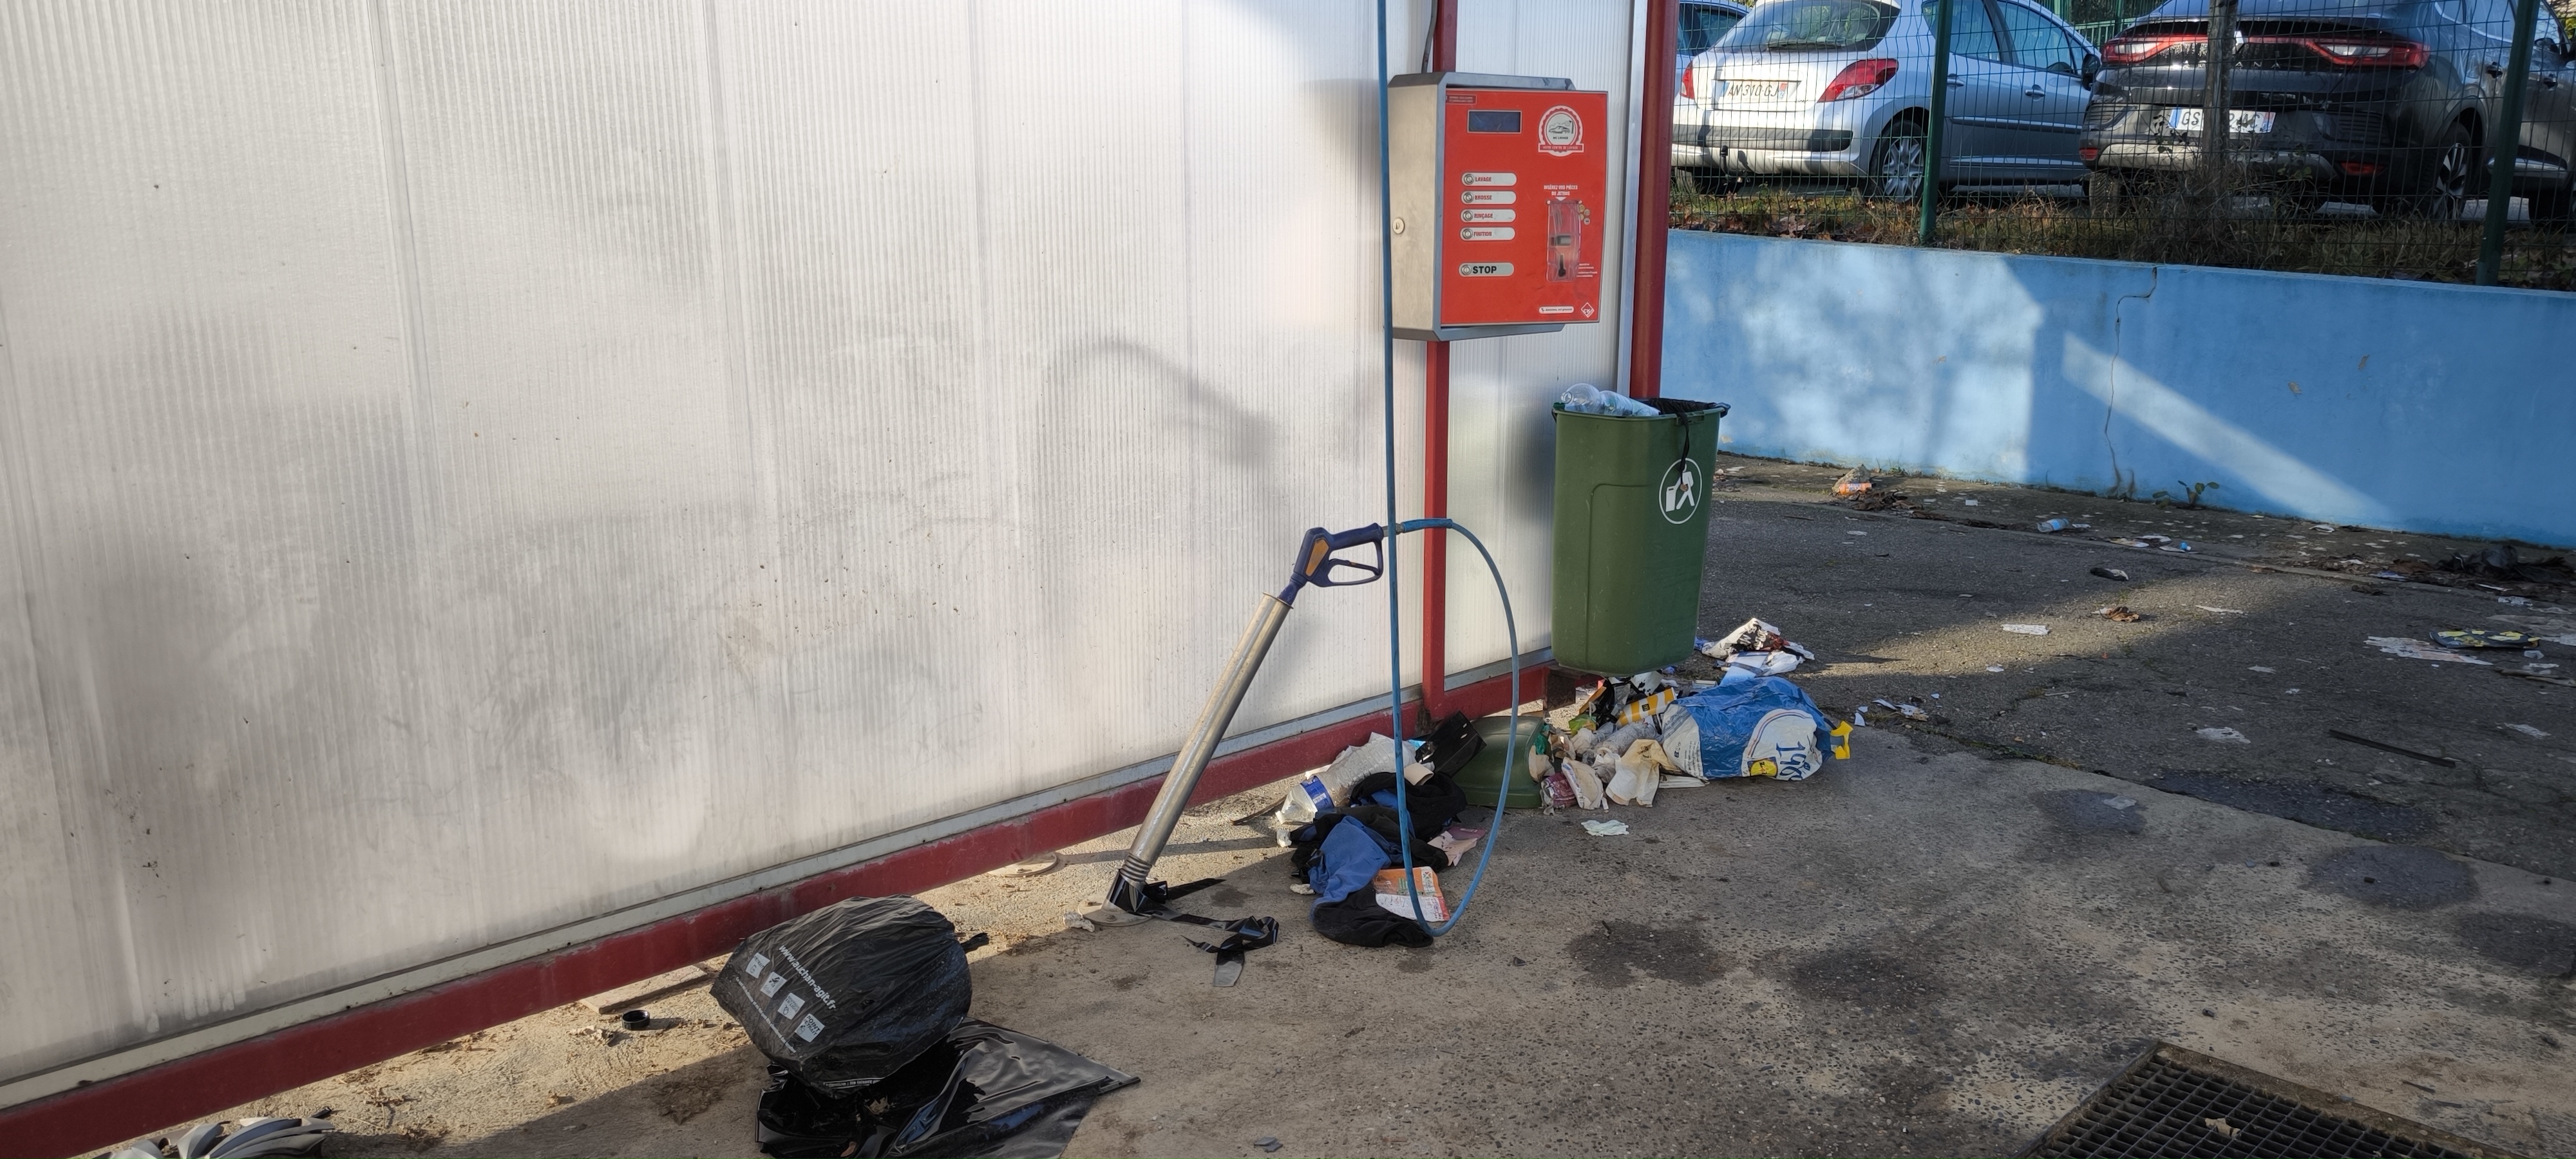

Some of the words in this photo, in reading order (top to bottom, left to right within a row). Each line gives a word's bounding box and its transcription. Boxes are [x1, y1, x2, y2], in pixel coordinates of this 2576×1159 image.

[1727, 84, 1779, 97] AN310-GJ
[2181, 111, 2201, 126] GS
[1472, 266, 1497, 274] STOP
[779, 945, 836, 1010] www.auchan-agit.fr
[807, 1016, 820, 1032] POINT
